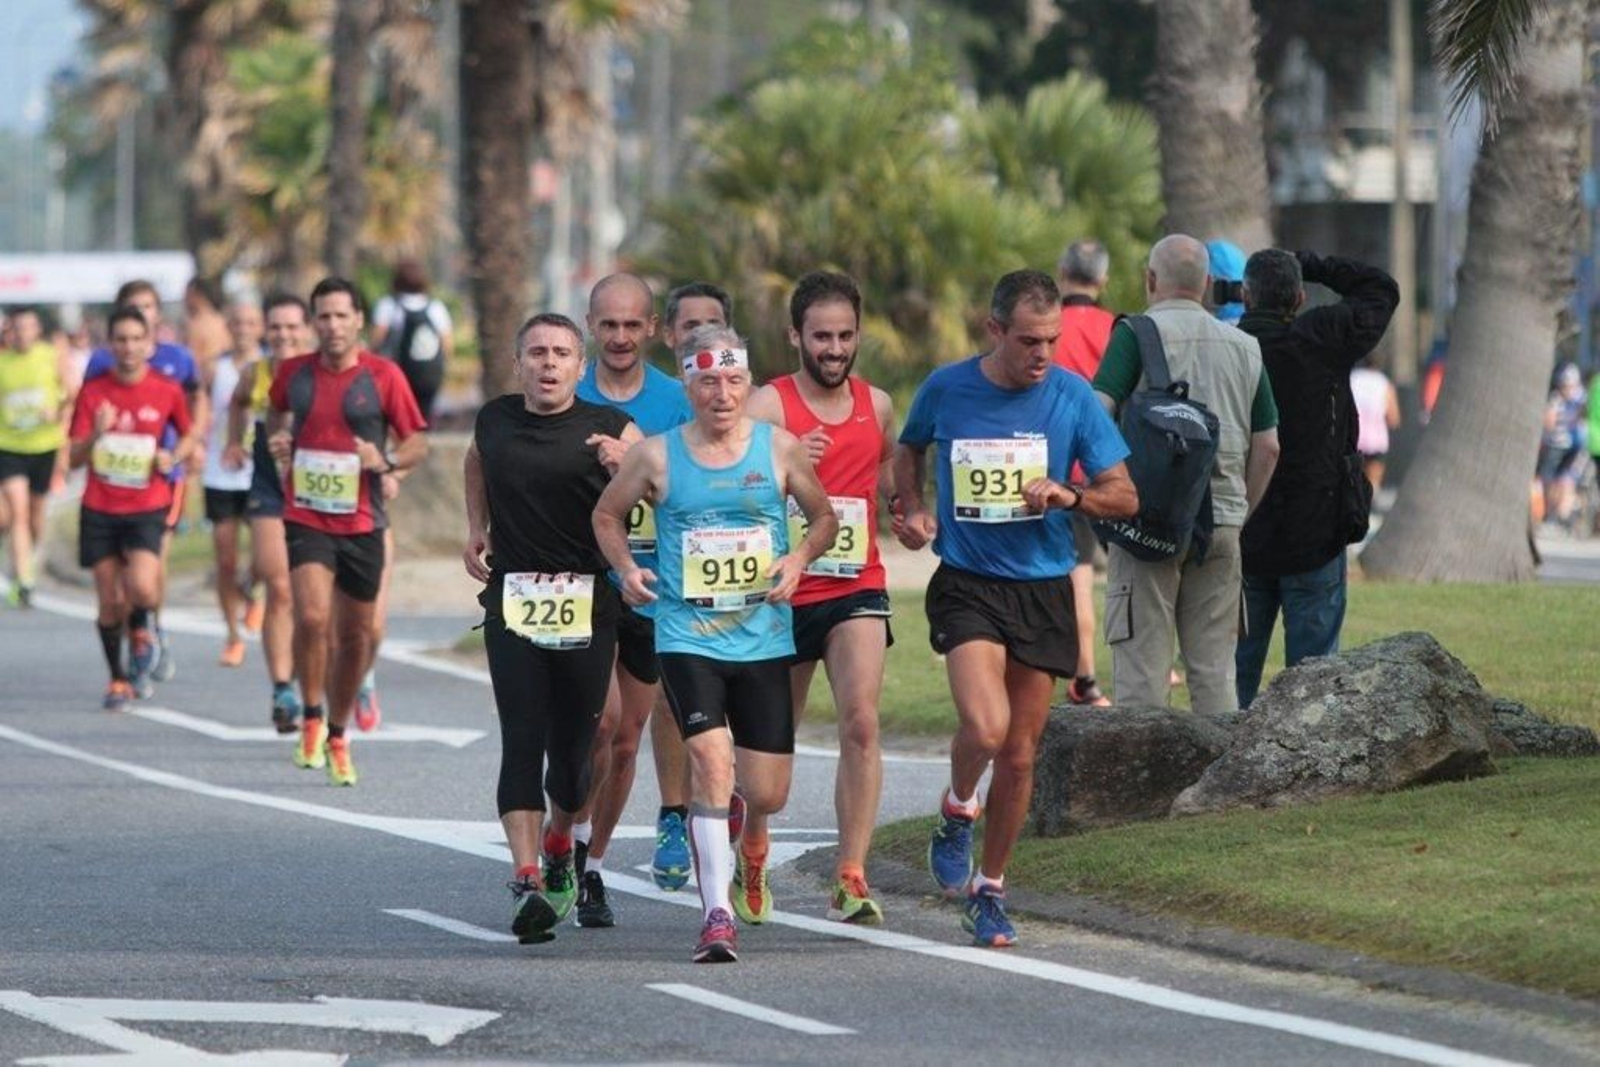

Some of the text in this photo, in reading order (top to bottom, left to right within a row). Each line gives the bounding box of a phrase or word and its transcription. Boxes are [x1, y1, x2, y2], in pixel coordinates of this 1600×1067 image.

[306, 472, 344, 494] 505
[969, 469, 1024, 496] 931
[1099, 519, 1176, 554] TALUNYA
[702, 556, 758, 585] 919
[521, 599, 574, 626] 226
